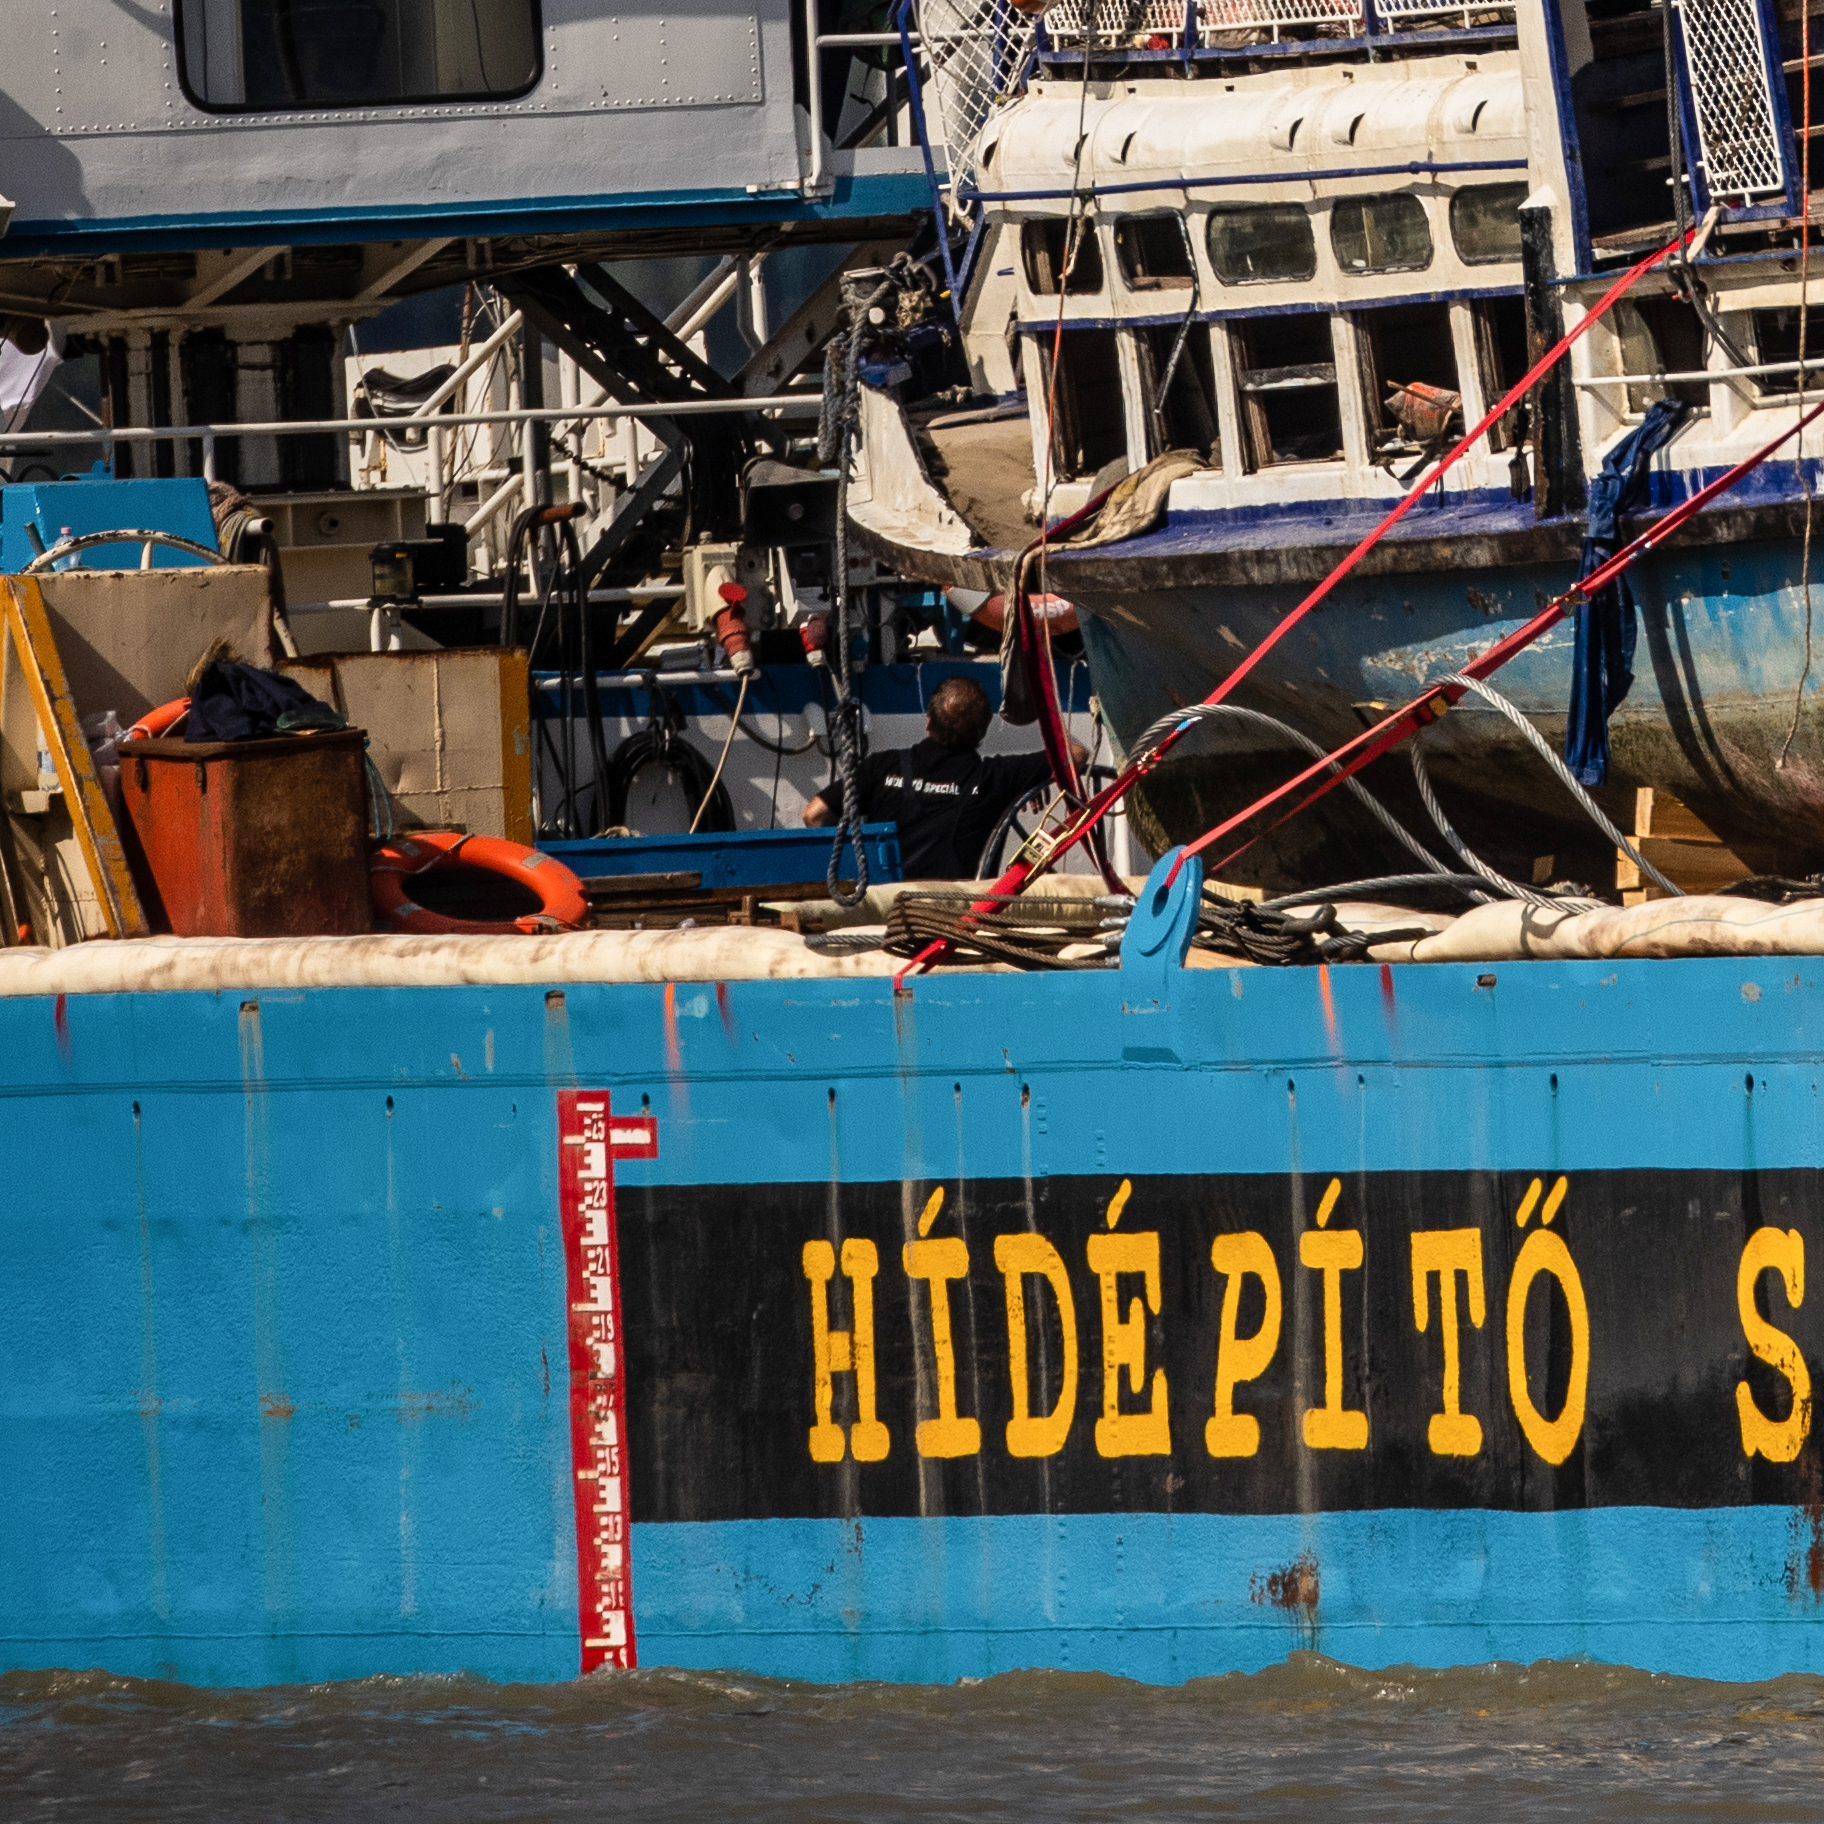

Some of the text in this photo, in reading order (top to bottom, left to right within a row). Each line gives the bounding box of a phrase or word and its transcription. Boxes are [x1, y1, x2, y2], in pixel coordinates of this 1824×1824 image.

[593, 1179, 607, 1208] 23
[596, 1247, 611, 1274] 21
[802, 1177, 1590, 1466] HÍDÉPÍTŐ
[606, 1446, 620, 1475] 15
